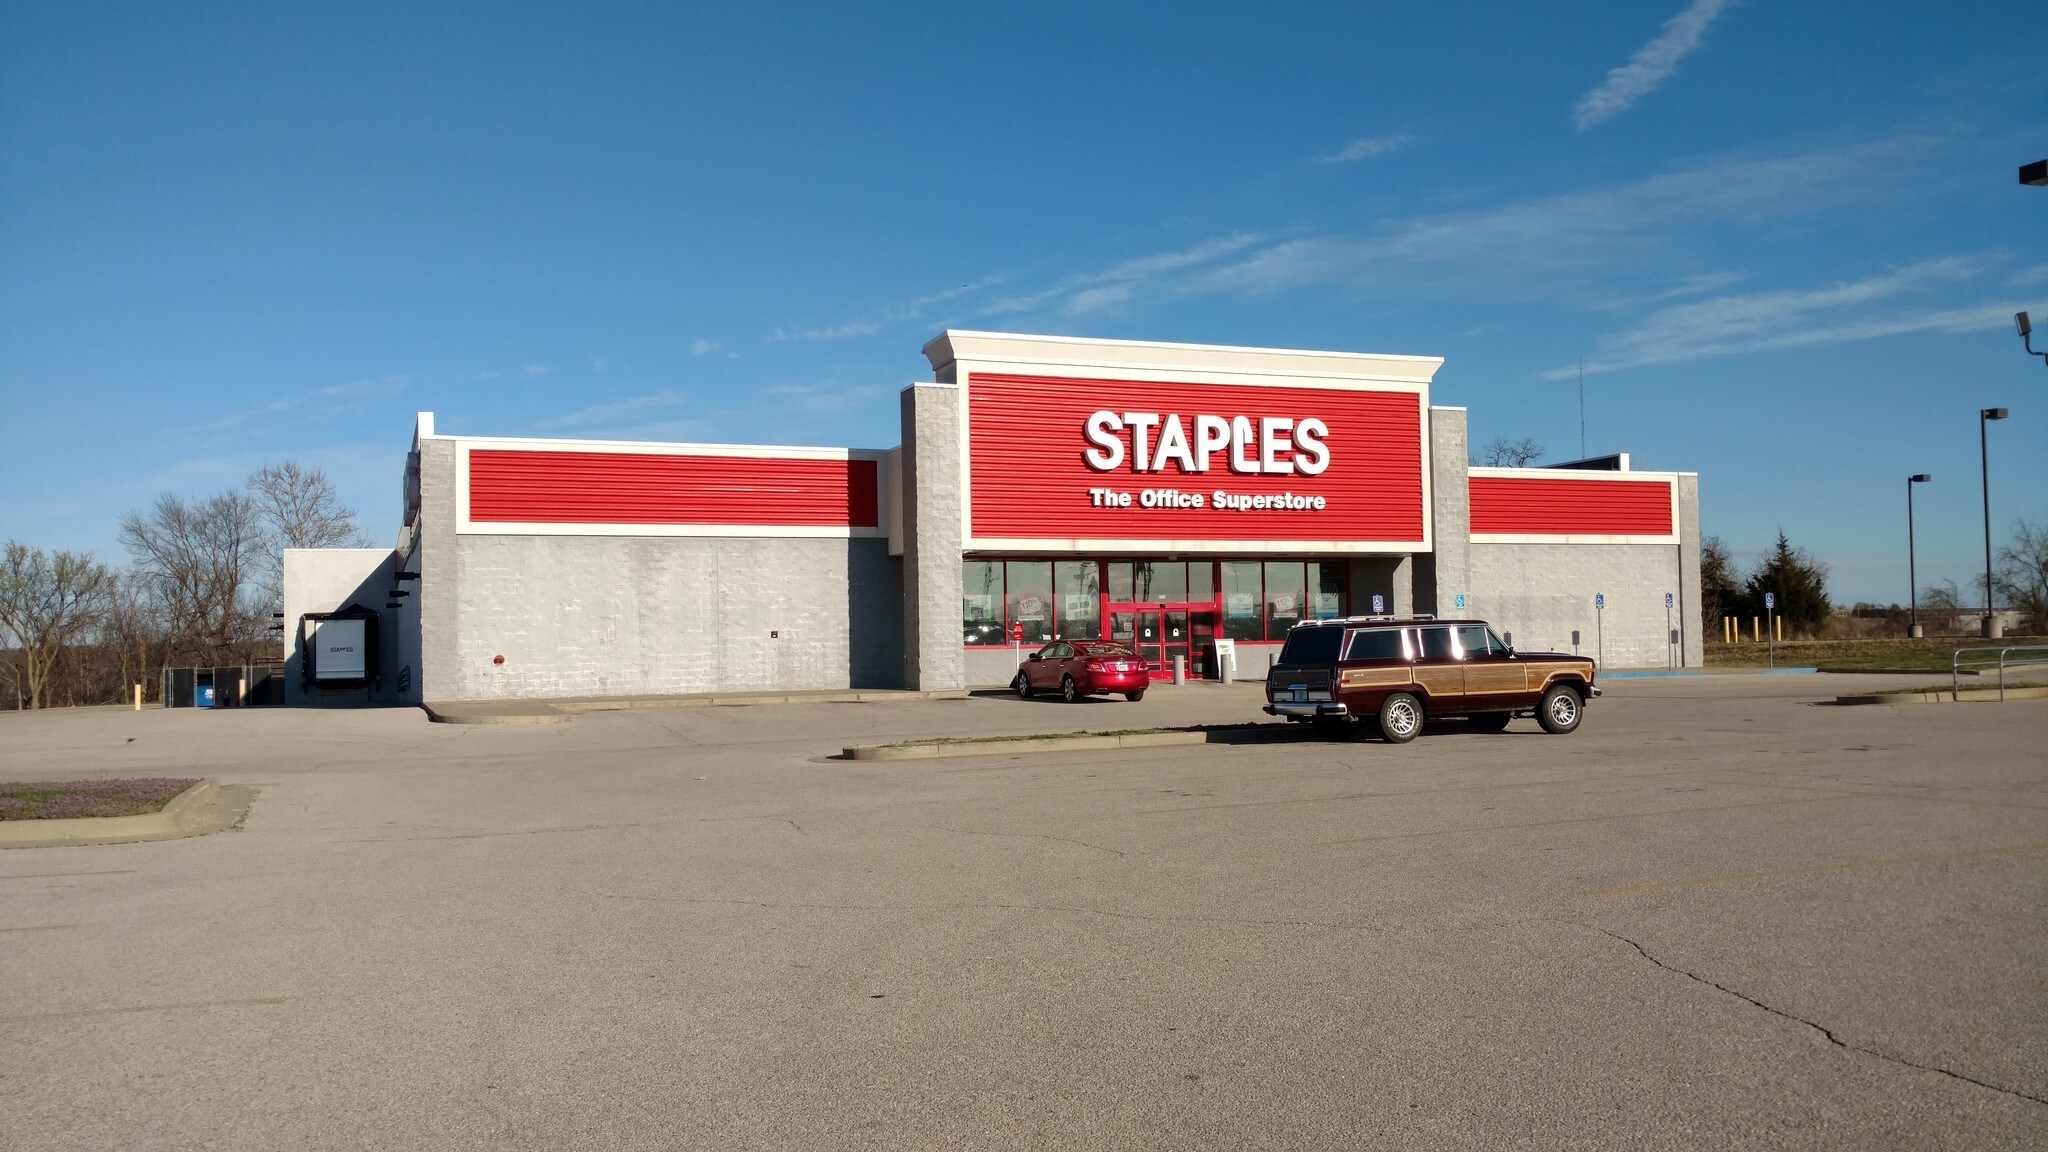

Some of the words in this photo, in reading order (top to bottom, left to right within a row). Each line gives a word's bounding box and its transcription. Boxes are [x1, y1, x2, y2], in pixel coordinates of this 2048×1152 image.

[1084, 410, 1331, 475] STAPLES
[1090, 488, 1131, 507] The
[1139, 489, 1204, 508] Office
[1212, 491, 1326, 511] Superstore
